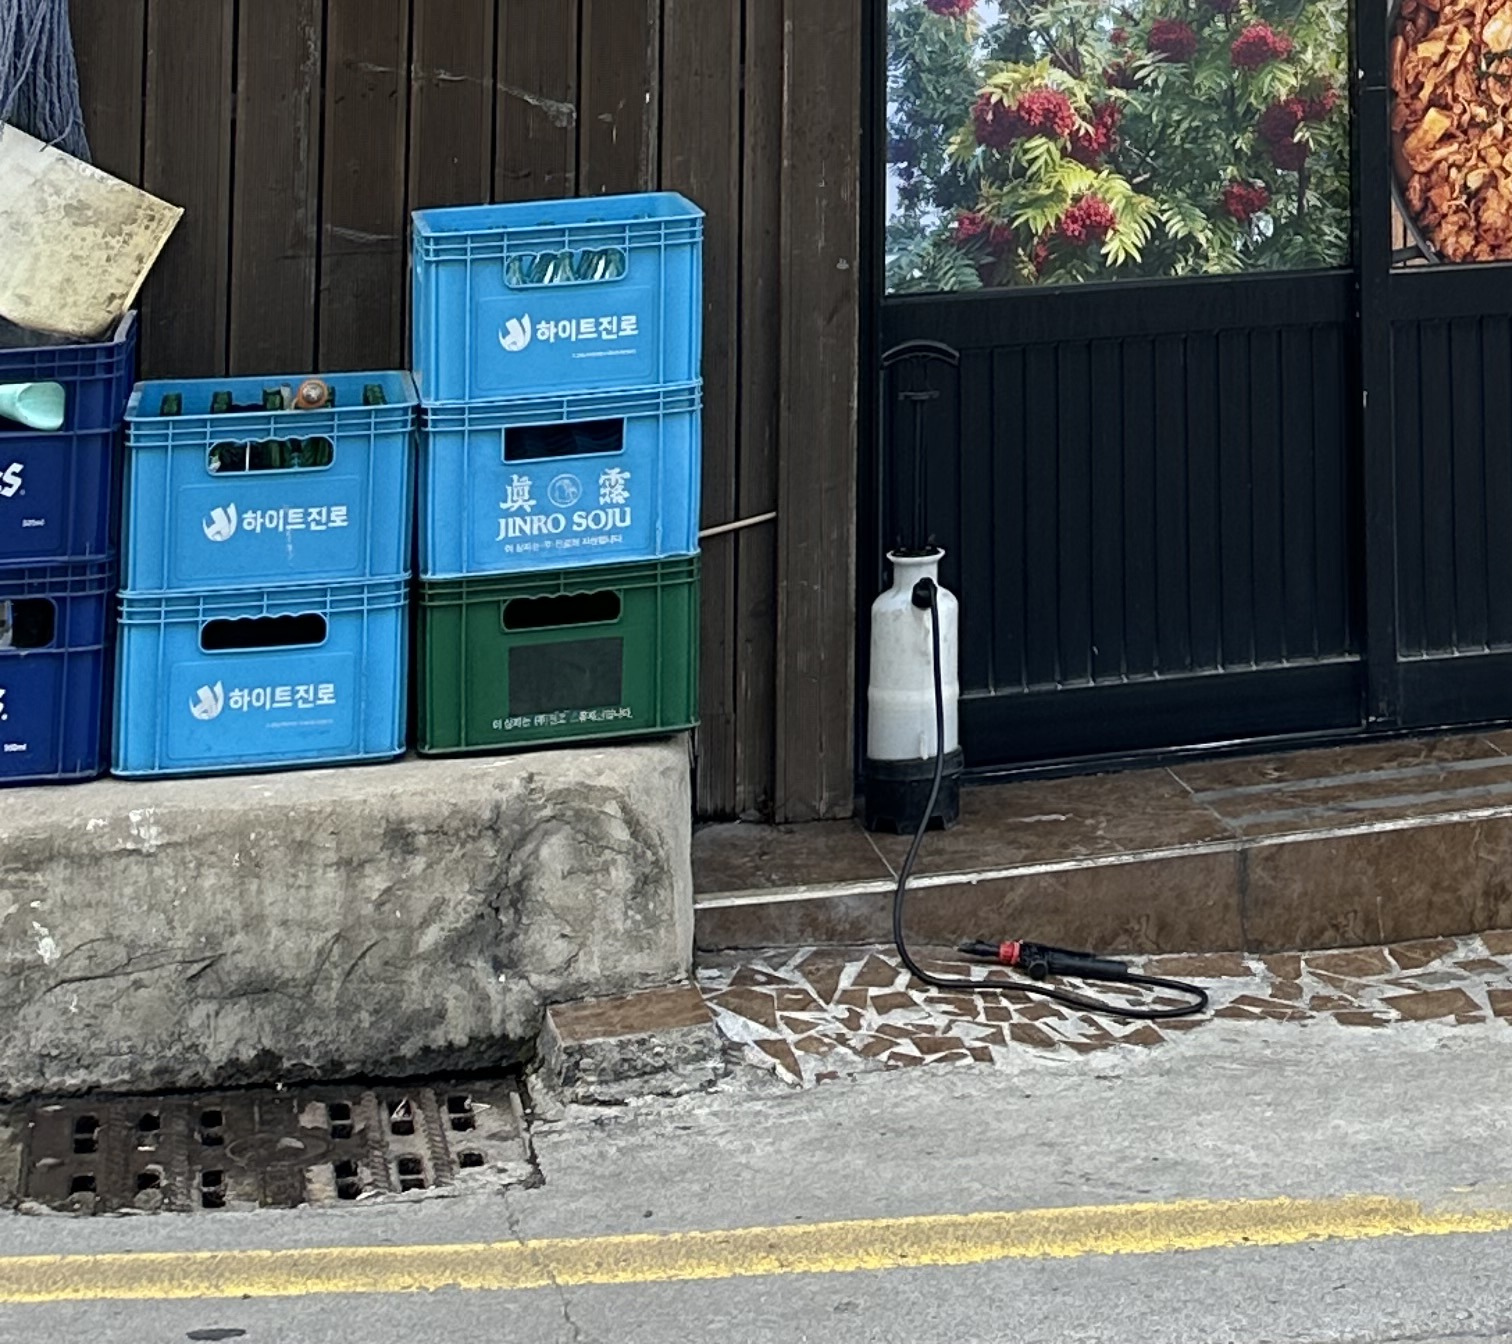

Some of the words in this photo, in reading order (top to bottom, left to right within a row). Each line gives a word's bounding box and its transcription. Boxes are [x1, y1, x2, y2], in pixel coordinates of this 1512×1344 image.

[535, 313, 640, 344] 하이트진로
[241, 503, 349, 534] 하이트진로
[495, 513, 566, 541] JINRO
[572, 507, 631, 531] SOJU
[228, 682, 337, 712] 하이트진로
